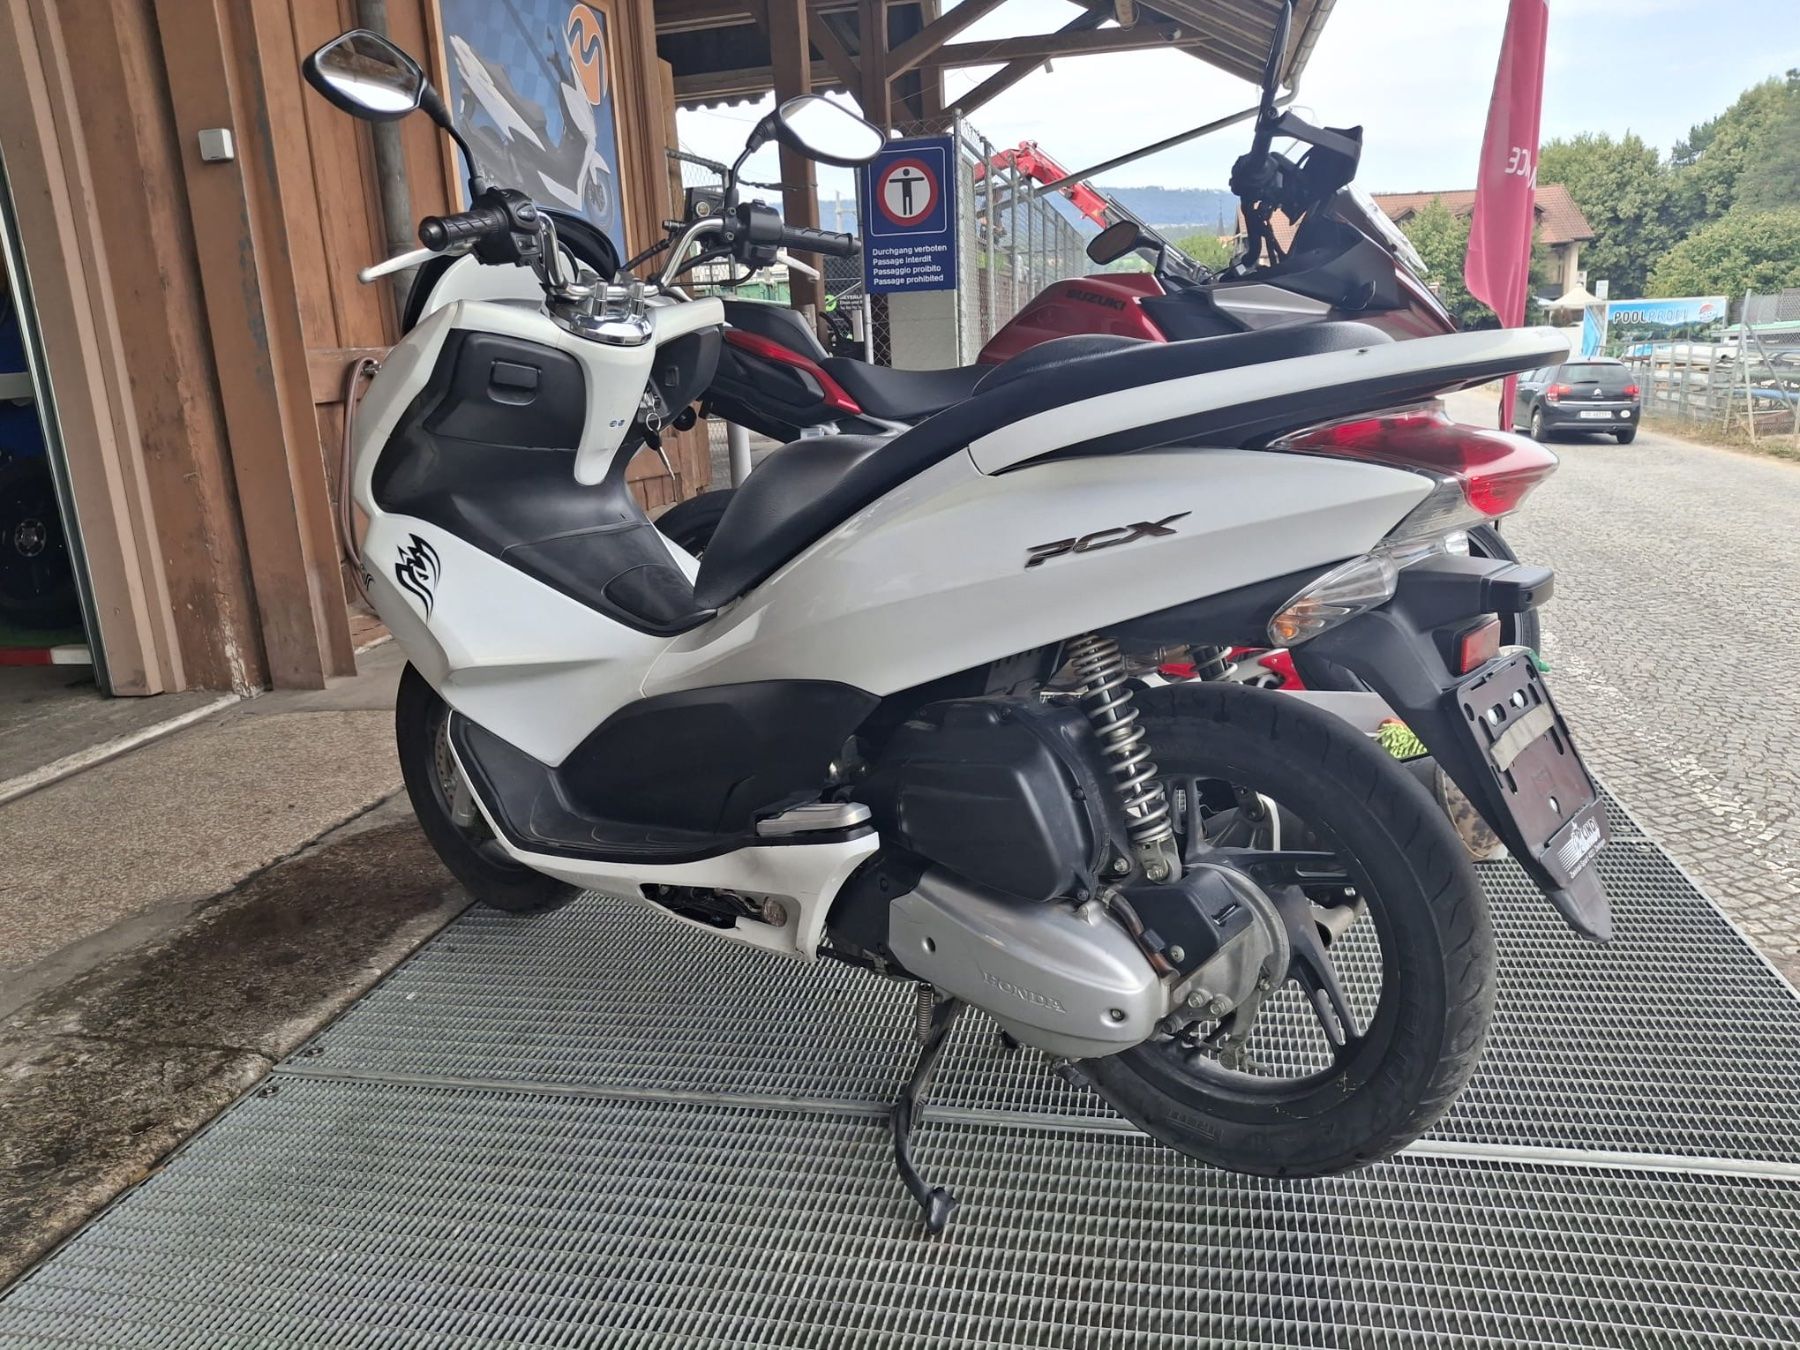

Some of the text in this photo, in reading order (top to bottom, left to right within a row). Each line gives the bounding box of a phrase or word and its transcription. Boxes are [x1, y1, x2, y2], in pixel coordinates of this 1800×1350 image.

[872, 245, 947, 256] Durchgang verboten
[872, 255, 932, 266] Passage interdit
[873, 265, 941, 275] Passaggio proibito
[906, 274, 944, 285] prohibited
[1065, 289, 1127, 312] SUZUKI
[1024, 511, 1193, 569] PCX
[983, 971, 1067, 1014] HONDA
